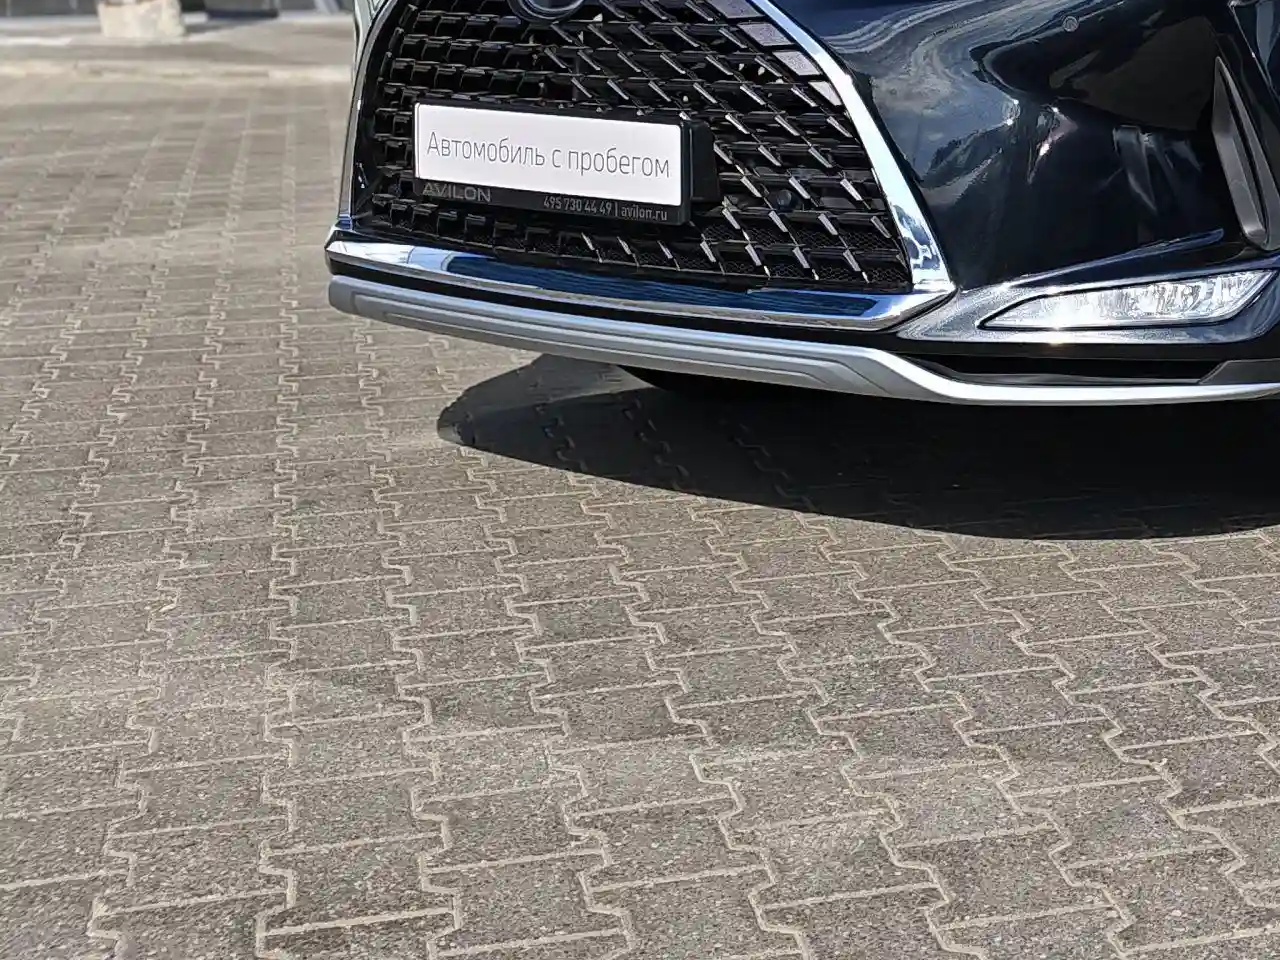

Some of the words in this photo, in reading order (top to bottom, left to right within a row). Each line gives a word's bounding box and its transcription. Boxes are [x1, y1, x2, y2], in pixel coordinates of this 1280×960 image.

[427, 131, 545, 166] Автомобиль
[552, 149, 562, 168] с
[568, 147, 670, 178] пробегом
[422, 182, 491, 203] AVILON
[543, 195, 562, 210] 495
[564, 197, 582, 212] 730
[584, 200, 597, 214] 44
[599, 201, 612, 216] 49
[621, 204, 668, 221] avilon.ru
